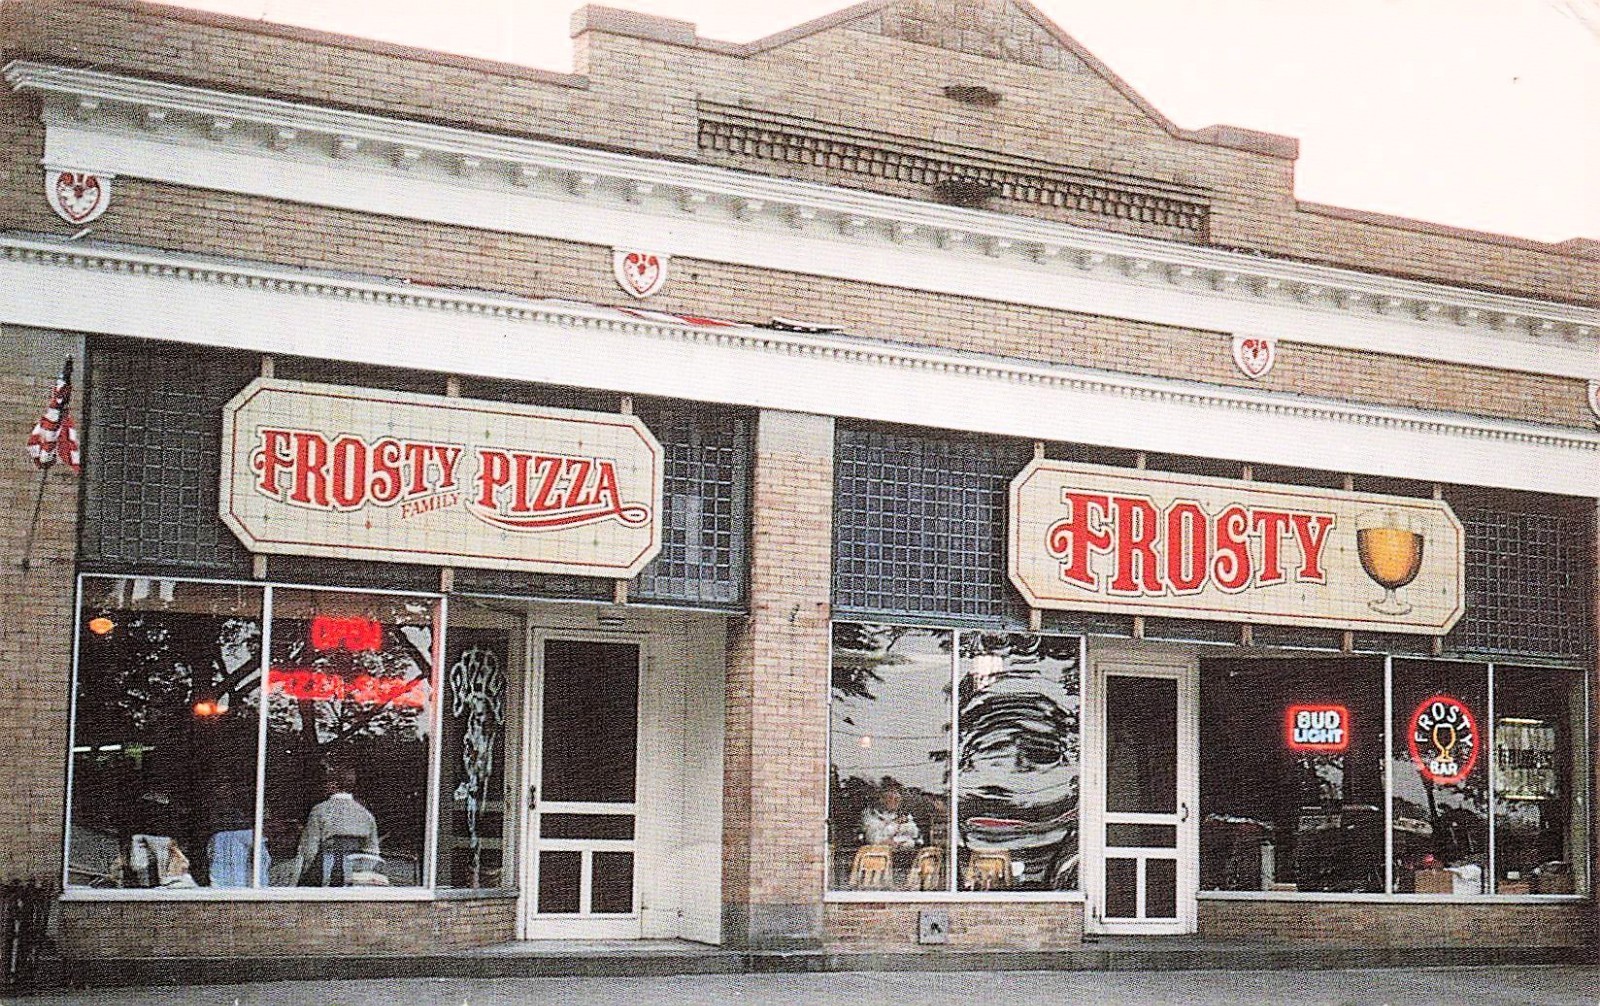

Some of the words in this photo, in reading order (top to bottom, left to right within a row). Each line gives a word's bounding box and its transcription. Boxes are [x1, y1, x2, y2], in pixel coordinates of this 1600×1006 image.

[253, 428, 462, 509] FROSTY
[468, 446, 647, 527] PIZZA
[401, 494, 459, 519] FAMILY
[1050, 492, 1334, 592] FROSTY
[1297, 711, 1341, 728] BUD
[1414, 702, 1474, 747] FROSTY
[1293, 728, 1345, 744] LIGHT
[1430, 760, 1459, 776] BAR
